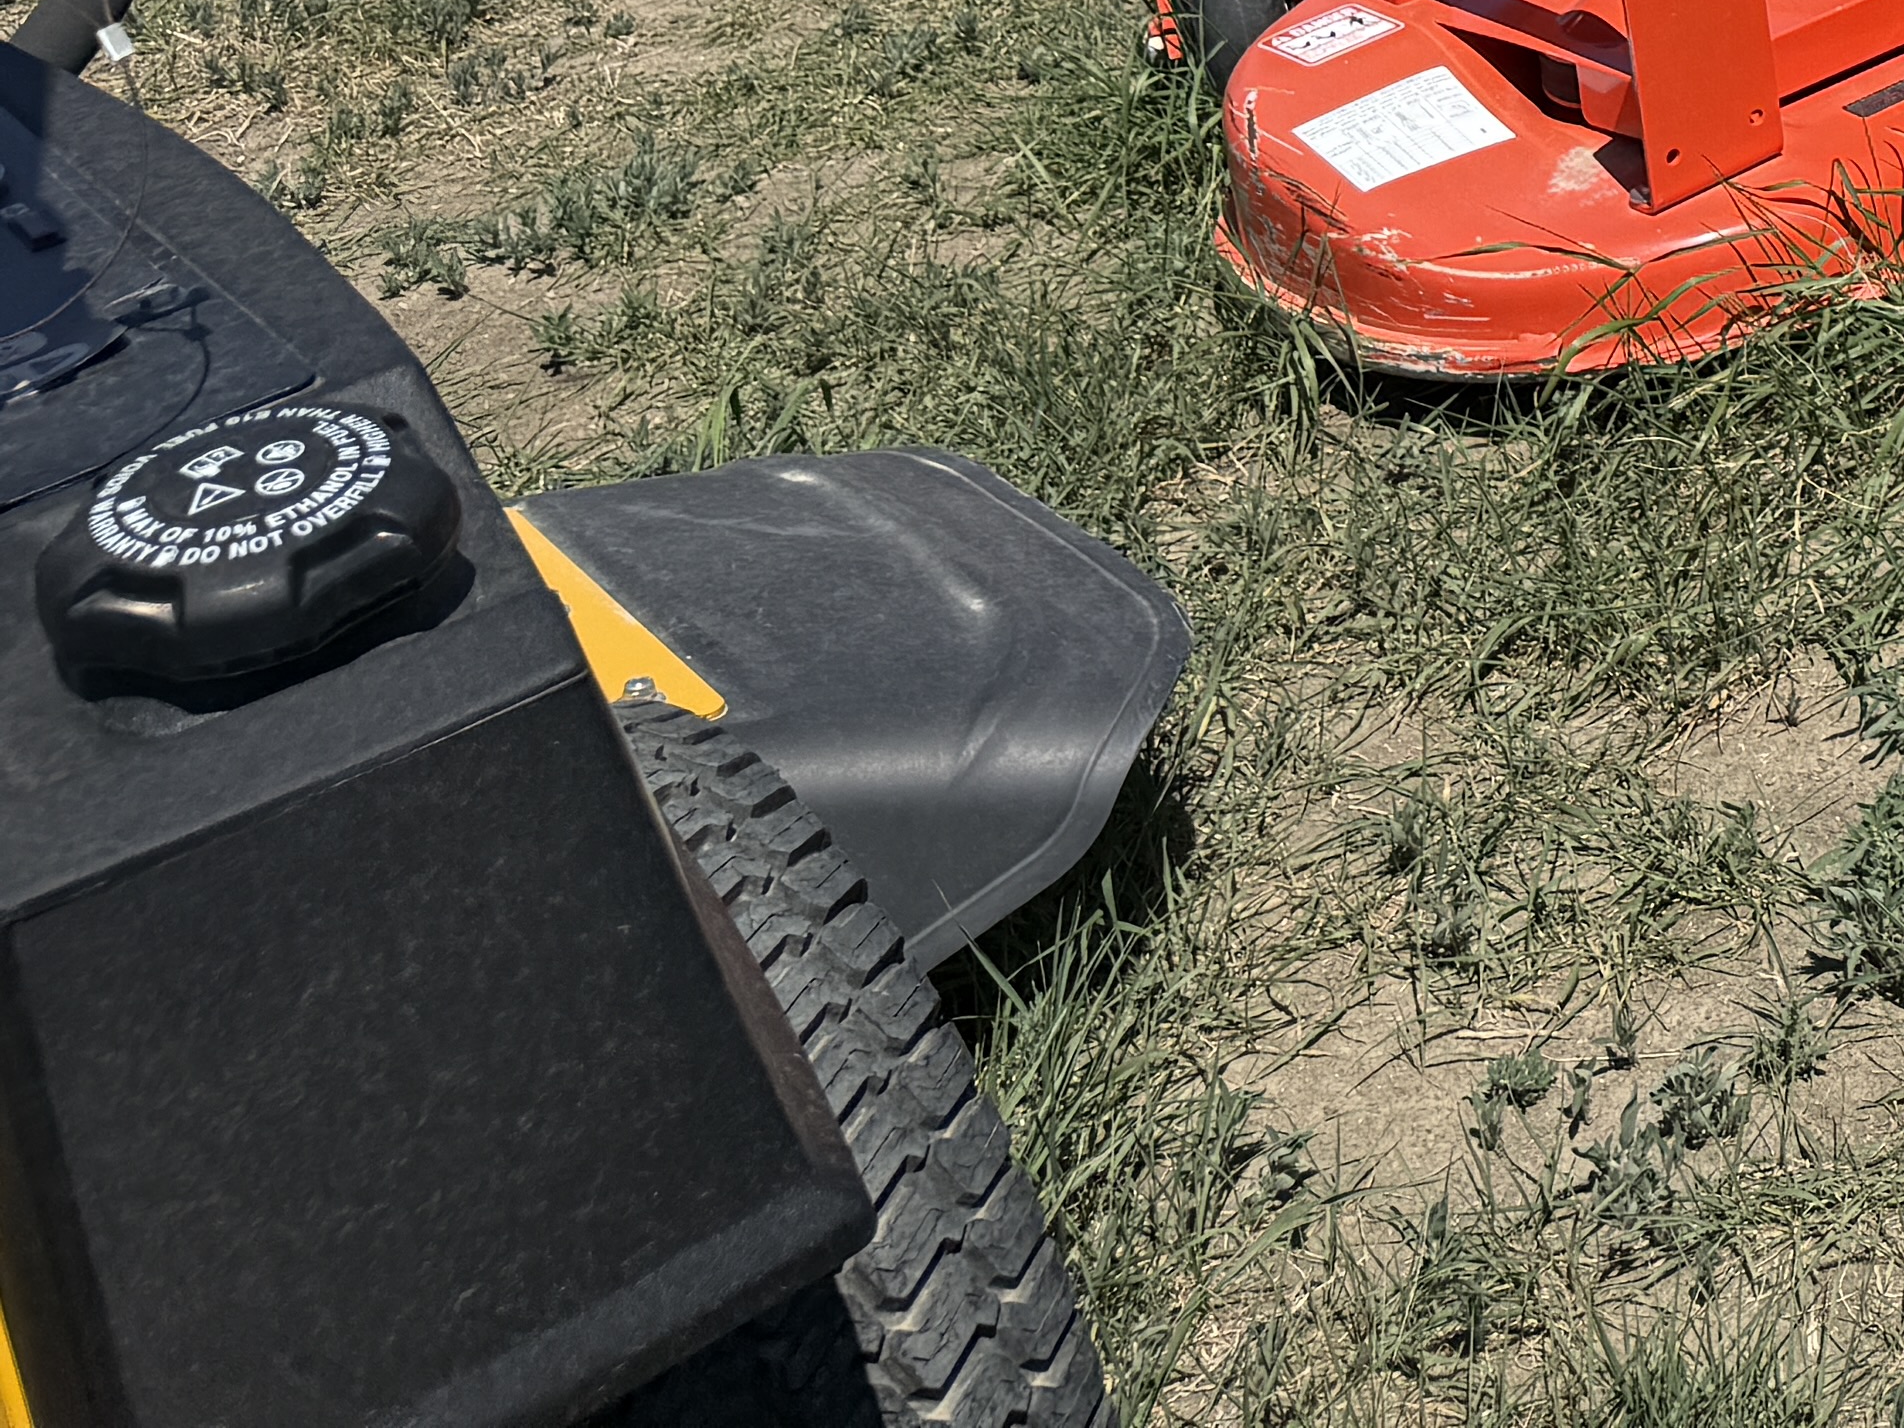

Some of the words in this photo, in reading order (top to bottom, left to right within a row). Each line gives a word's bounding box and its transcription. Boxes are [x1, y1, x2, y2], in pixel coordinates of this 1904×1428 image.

[224, 409, 271, 427] E10
[276, 406, 341, 424] THAN
[151, 422, 219, 451] FUEL
[312, 419, 357, 445] FUEL
[339, 413, 390, 459] HIGHER
[338, 445, 360, 461] IN
[264, 462, 358, 529] ETHANOL
[87, 496, 160, 564] WARRANTY
[121, 508, 165, 539] MAX
[178, 546, 221, 566] DO
[228, 529, 284, 560] NOT
[290, 469, 386, 536] OVERFILL
[158, 527, 198, 543] OF
[202, 521, 257, 543] 10%
